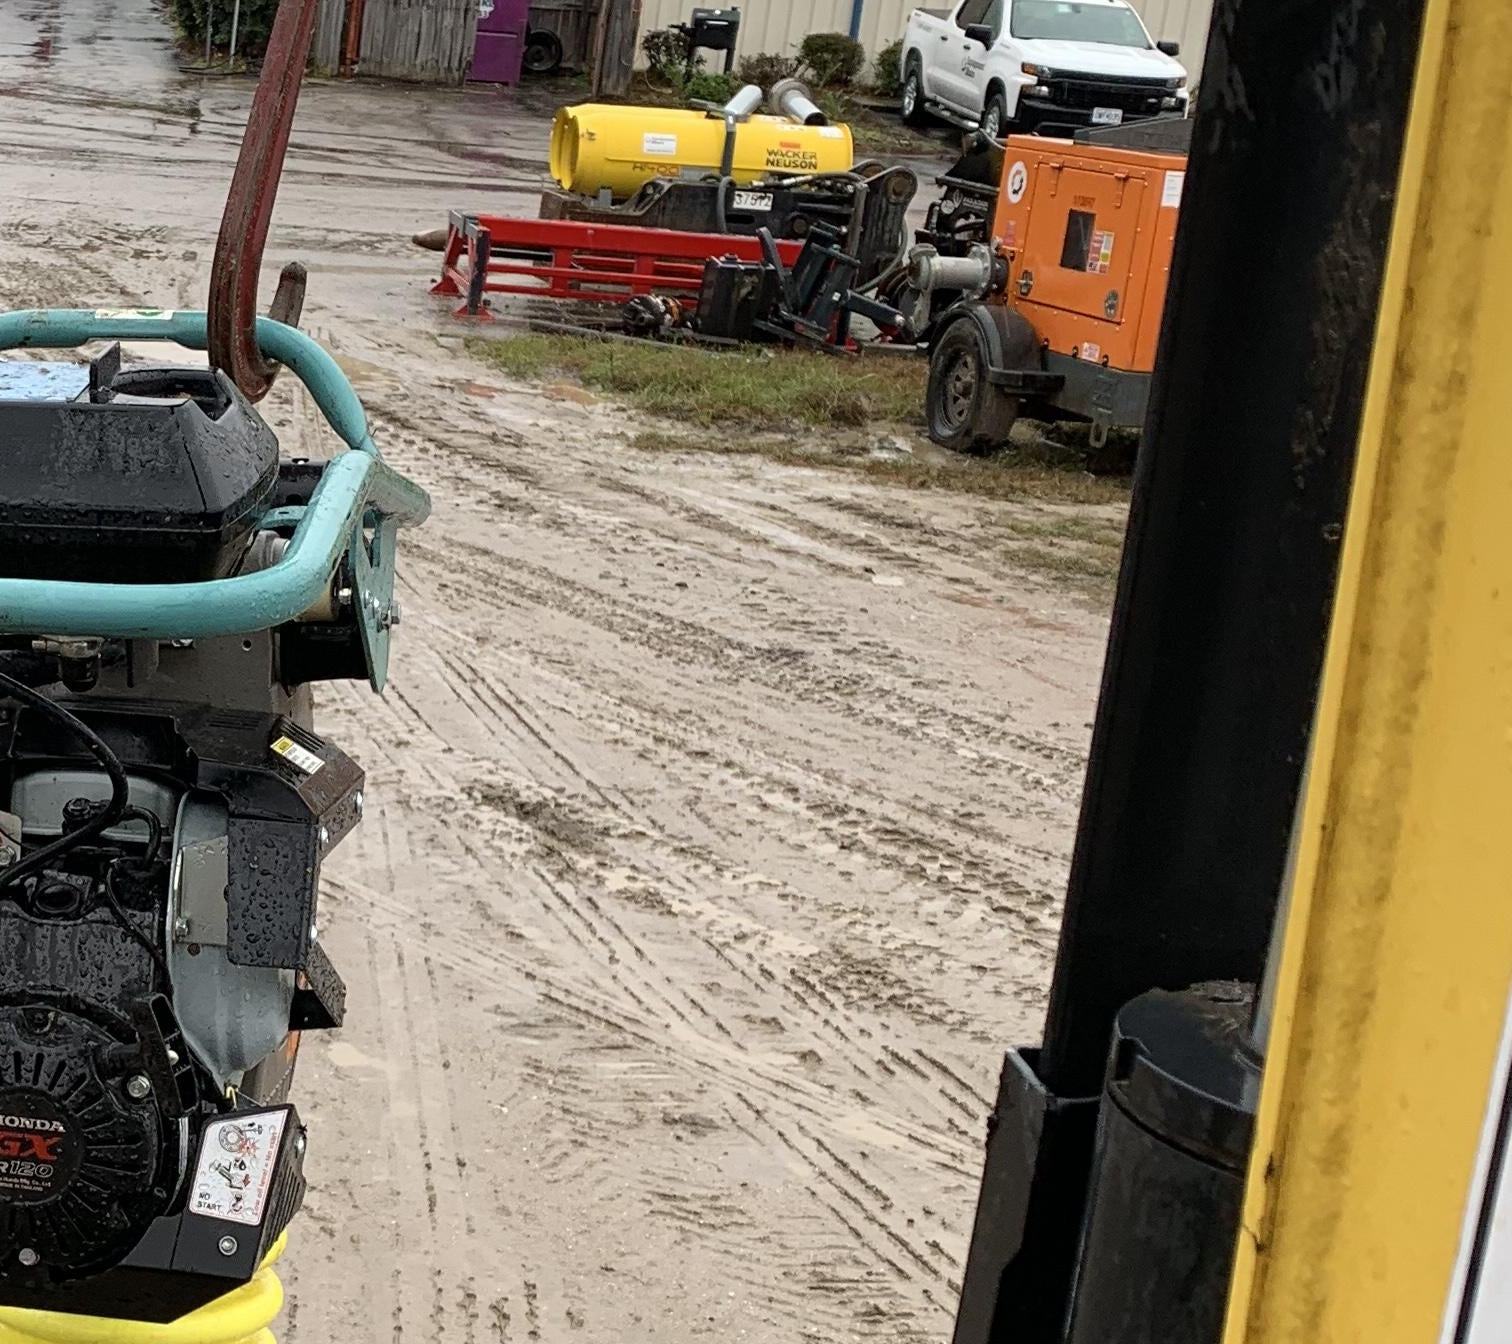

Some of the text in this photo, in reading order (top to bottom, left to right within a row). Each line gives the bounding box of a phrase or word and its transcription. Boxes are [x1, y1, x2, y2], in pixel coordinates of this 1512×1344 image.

[767, 148, 818, 160] WACKER
[766, 158, 818, 170] NEUSON
[199, 1192, 211, 1201] NO
[197, 1201, 222, 1212] START
